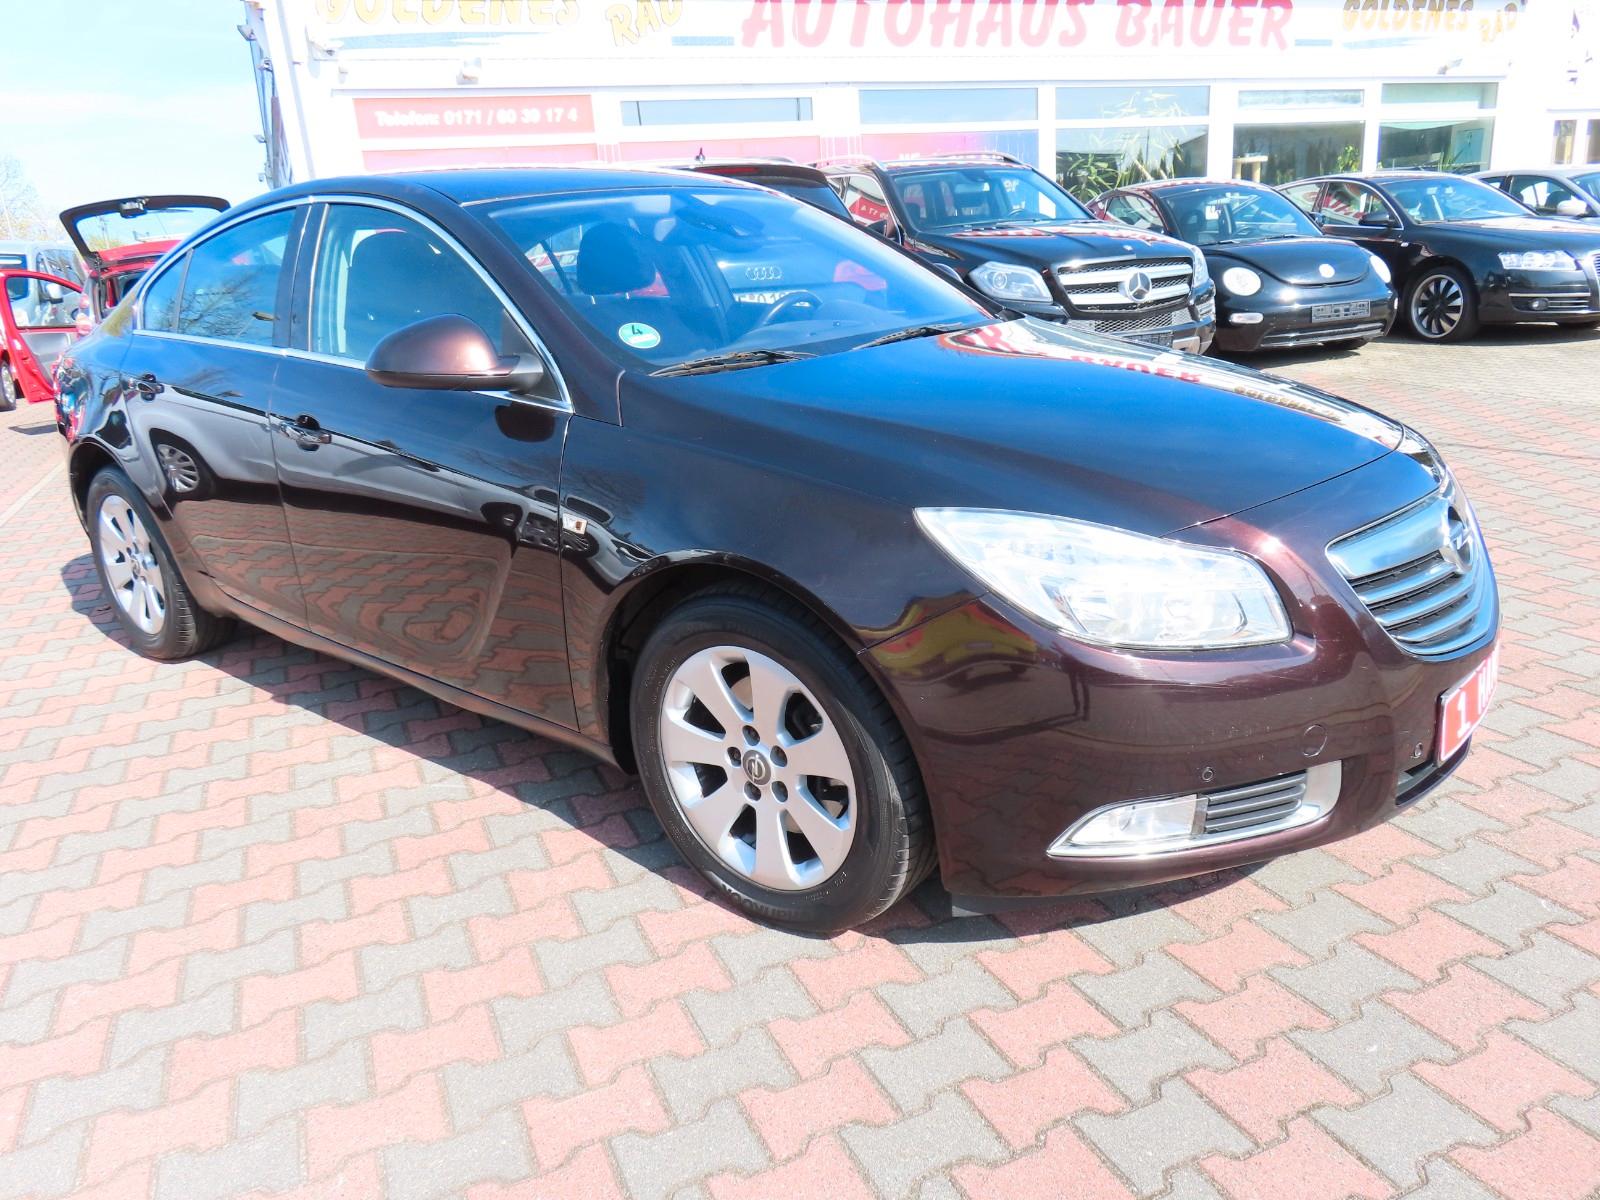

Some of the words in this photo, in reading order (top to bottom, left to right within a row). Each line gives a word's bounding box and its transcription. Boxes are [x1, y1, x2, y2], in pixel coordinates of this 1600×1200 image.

[741, 0, 1095, 48] AUTOHAUS
[1115, 0, 1293, 51] BAUER
[443, 109, 483, 126] 0171
[545, 107, 564, 123] 17
[567, 106, 578, 122] 4
